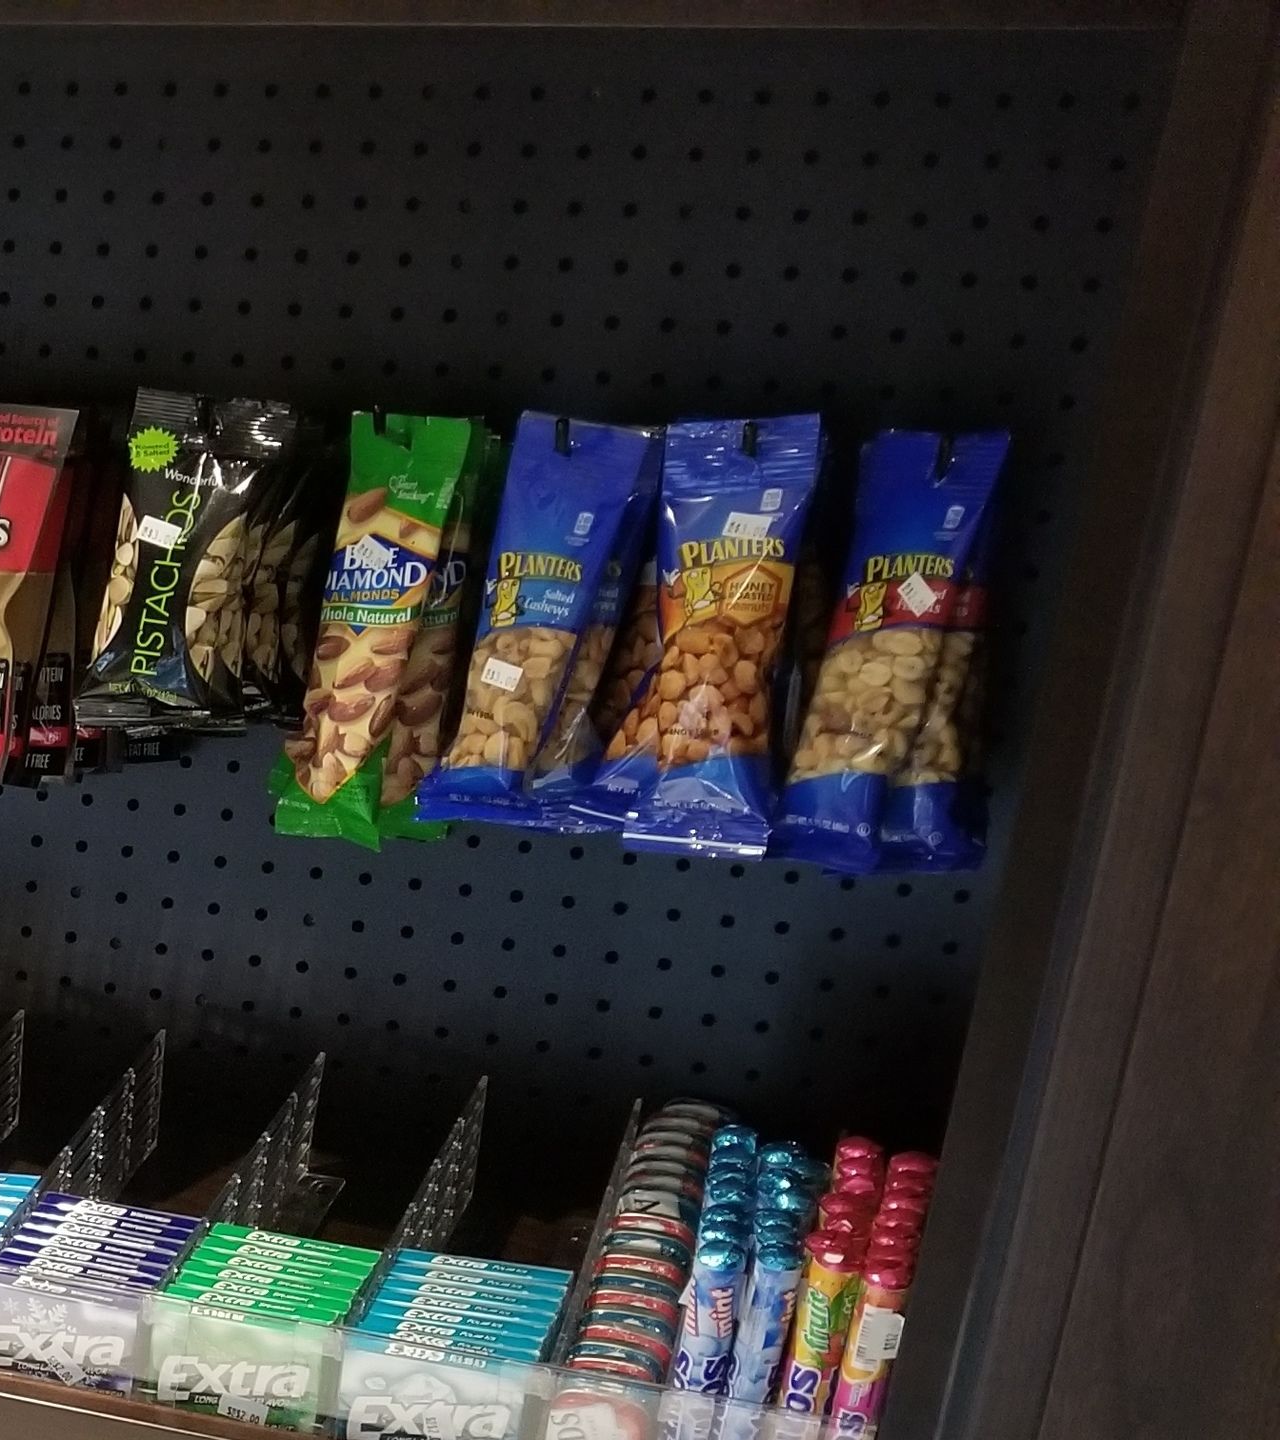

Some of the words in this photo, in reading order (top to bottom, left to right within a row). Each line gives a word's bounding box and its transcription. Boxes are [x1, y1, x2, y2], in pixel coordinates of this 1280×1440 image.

[680, 537, 785, 567] PLANTERS
[501, 552, 582, 583] PLANTERS
[867, 556, 954, 581] PLANTERS
[329, 588, 400, 602] ALMONDS
[729, 581, 775, 592] HONEY
[545, 589, 575, 604] Salted
[357, 606, 411, 624] Natural
[523, 598, 569, 617] Cashews
[74, 1200, 128, 1216] Extra
[244, 1230, 302, 1248] Extra
[430, 1255, 489, 1270] Extra
[716, 1286, 734, 1338] mint
[803, 1291, 829, 1353] fruit
[157, 1355, 310, 1400] Extra
[345, 1396, 512, 1440] Extra
